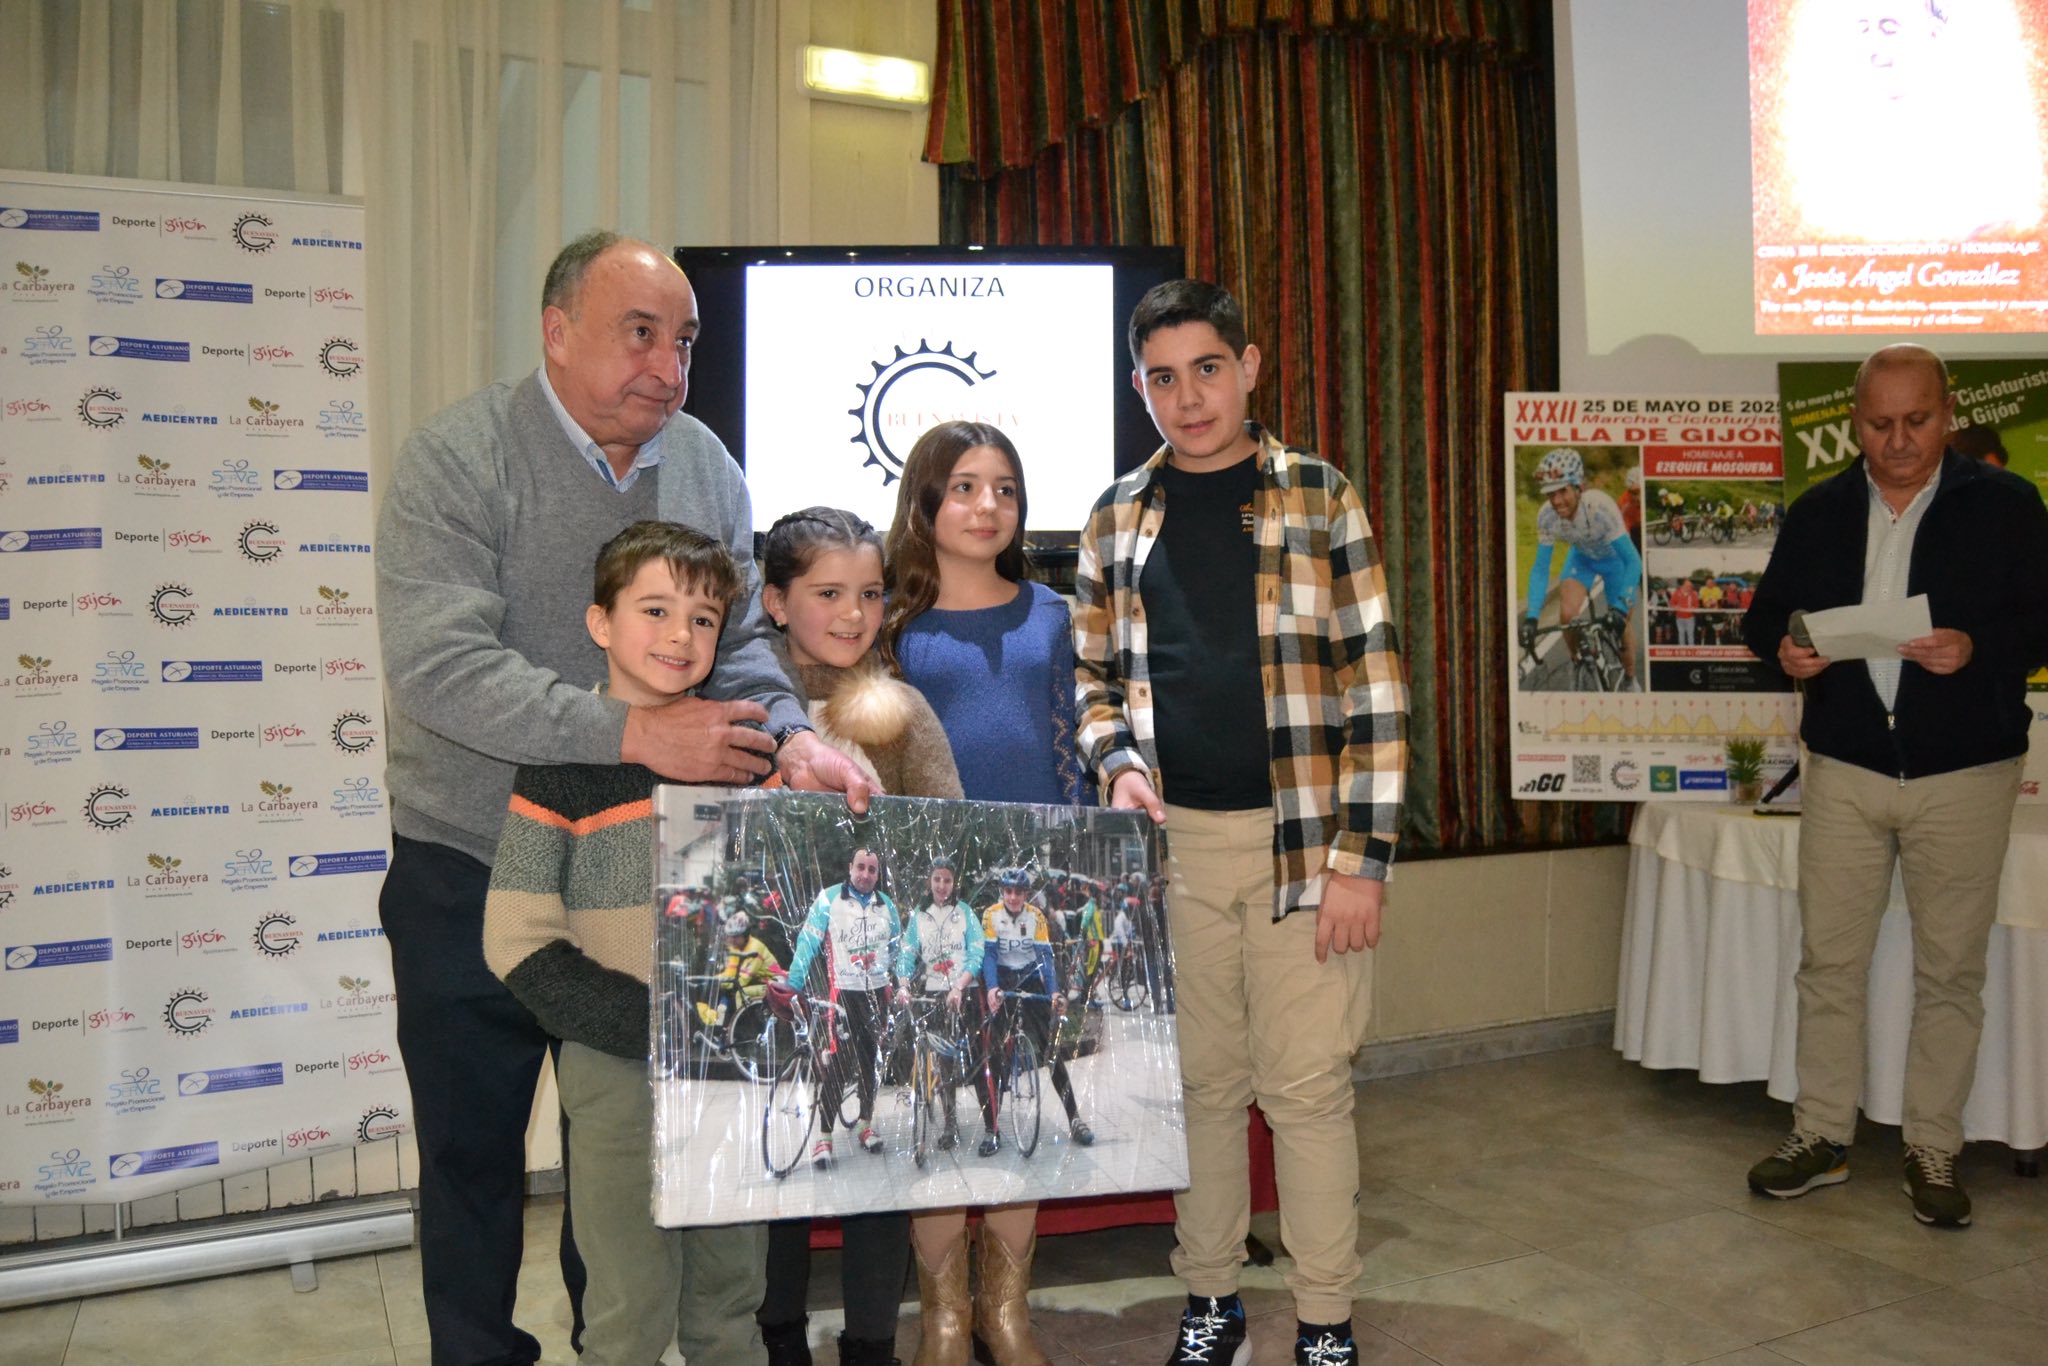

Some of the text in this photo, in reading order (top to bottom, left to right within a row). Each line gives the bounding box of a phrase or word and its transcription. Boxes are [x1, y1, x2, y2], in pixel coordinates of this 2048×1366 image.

[112, 216, 156, 229] Deporte
[165, 217, 207, 233] gijón
[292, 238, 362, 250] MEDICENTRO
[1917, 261, 2021, 288] González
[13, 279, 75, 294] Carbayera
[186, 283, 253, 293] DEPORTE ASTURIANO
[854, 276, 1006, 299] ORGANIZA
[265, 287, 354, 303] Deporte gijón
[151, 343, 190, 351] ASTURIANO
[202, 345, 294, 361] Deporte gijón
[1956, 369, 2048, 407] Cicloturist
[7, 399, 51, 416] gijón
[1583, 400, 1606, 413] 25
[1613, 400, 1638, 413] DE
[1645, 400, 1701, 413] MAYO
[1708, 400, 1734, 413] DE
[1807, 394, 1833, 406] mayo
[142, 413, 218, 424] MEDICENTRO
[1515, 399, 1578, 424] XXXII
[229, 414, 304, 429] La Carbayera
[1581, 413, 1781, 426] Marcha Cicloturist
[1514, 423, 1781, 442] VILLA DE GIJÓN
[1682, 450, 1744, 459] HOMENAJE A
[1656, 461, 1774, 474] EZEQUIEL MOSQUERA
[27, 474, 105, 486] MEDICENTRO
[118, 472, 196, 488] La Carbayera
[115, 529, 212, 548] Deporte gijón
[299, 544, 371, 553] MEDICENTRO
[23, 592, 122, 611] Deporte gijón
[213, 607, 288, 616] MEDICENTRO
[300, 604, 373, 618] La Carbayera
[274, 658, 366, 676] Deporte gijón
[16, 672, 79, 687] Carbayera
[211, 724, 306, 741] Deporte gijón
[10, 801, 56, 821] gijón
[151, 805, 229, 817] MEDICENTRO
[241, 799, 318, 813] La Carbayera
[319, 854, 387, 864] DEPORTE ASTURIANO
[33, 879, 115, 895] MEDICENTRO
[127, 872, 209, 887] La Carbayera
[126, 929, 226, 950] Deporte gijón
[317, 927, 387, 942] MEDICENTR
[38, 942, 113, 955] DEPORTE ASTURIANO
[320, 992, 397, 1009] La Carbayera
[175, 1008, 216, 1017] BUENAVISTA
[230, 1002, 308, 1019] MEDICENTRO
[32, 1018, 79, 1032] Deporte
[295, 1049, 391, 1074] Deporte gijón
[210, 1067, 282, 1081] DEPORTE ASTURIANO
[6, 1095, 92, 1115] La Carbayera
[232, 1126, 331, 1152] Deporte gijón
